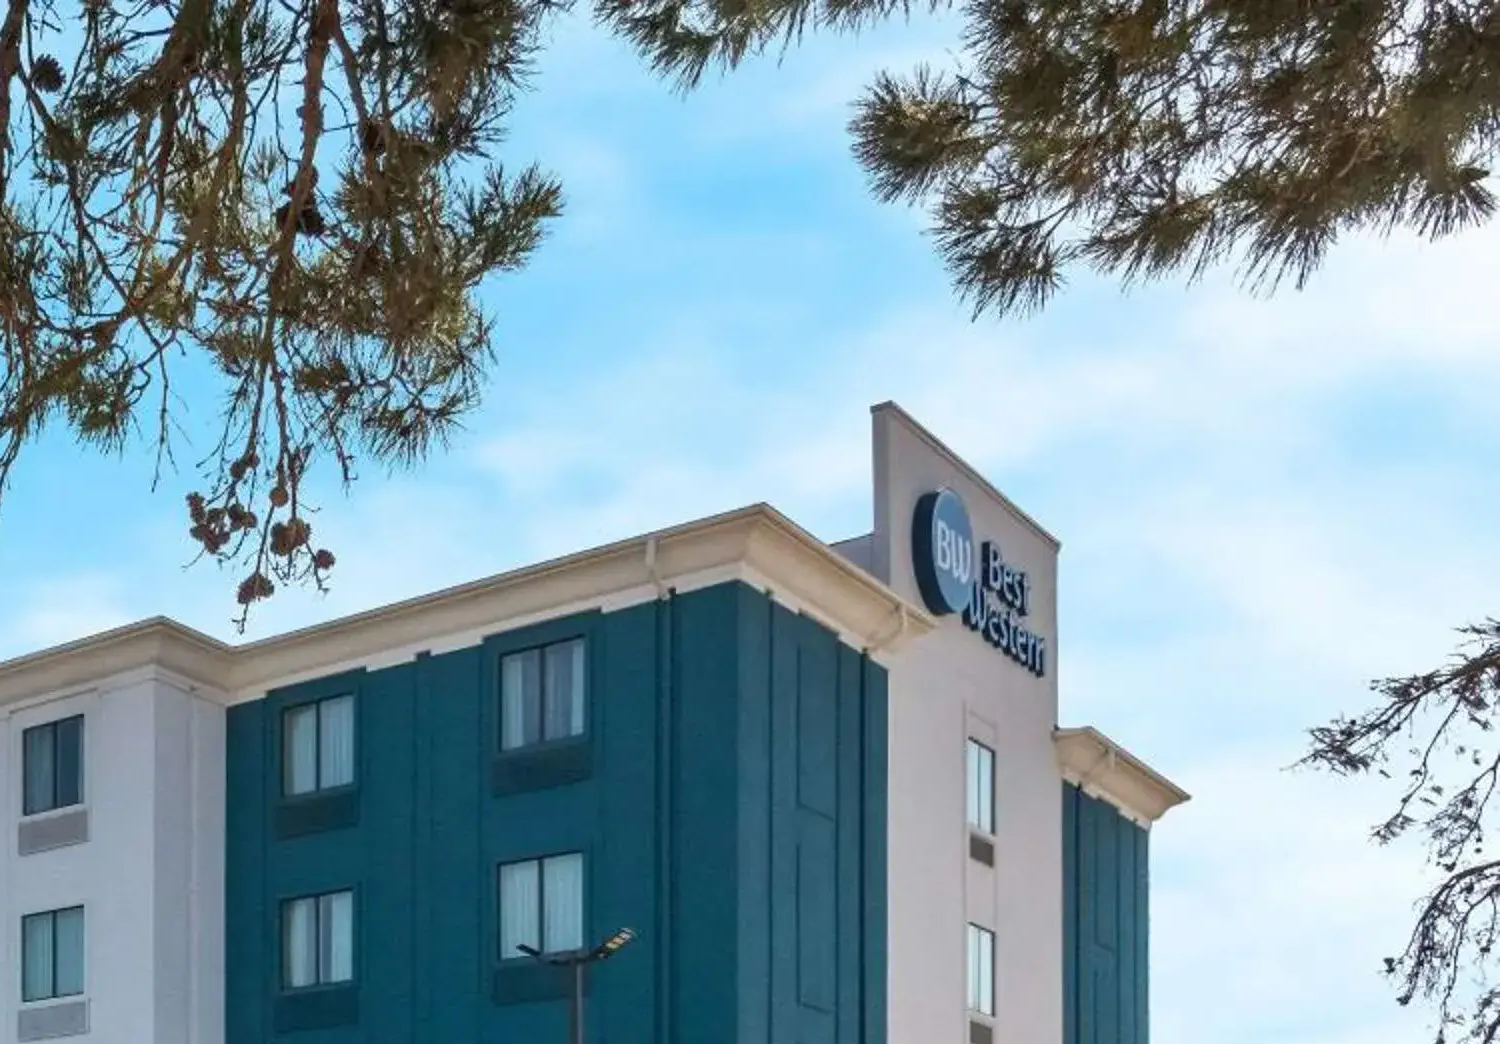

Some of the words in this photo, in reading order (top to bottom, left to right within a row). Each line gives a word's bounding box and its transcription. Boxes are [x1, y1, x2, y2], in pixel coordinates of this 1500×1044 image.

[937, 520, 971, 583] BW
[982, 542, 1030, 616] Best
[963, 578, 1044, 677] Western
